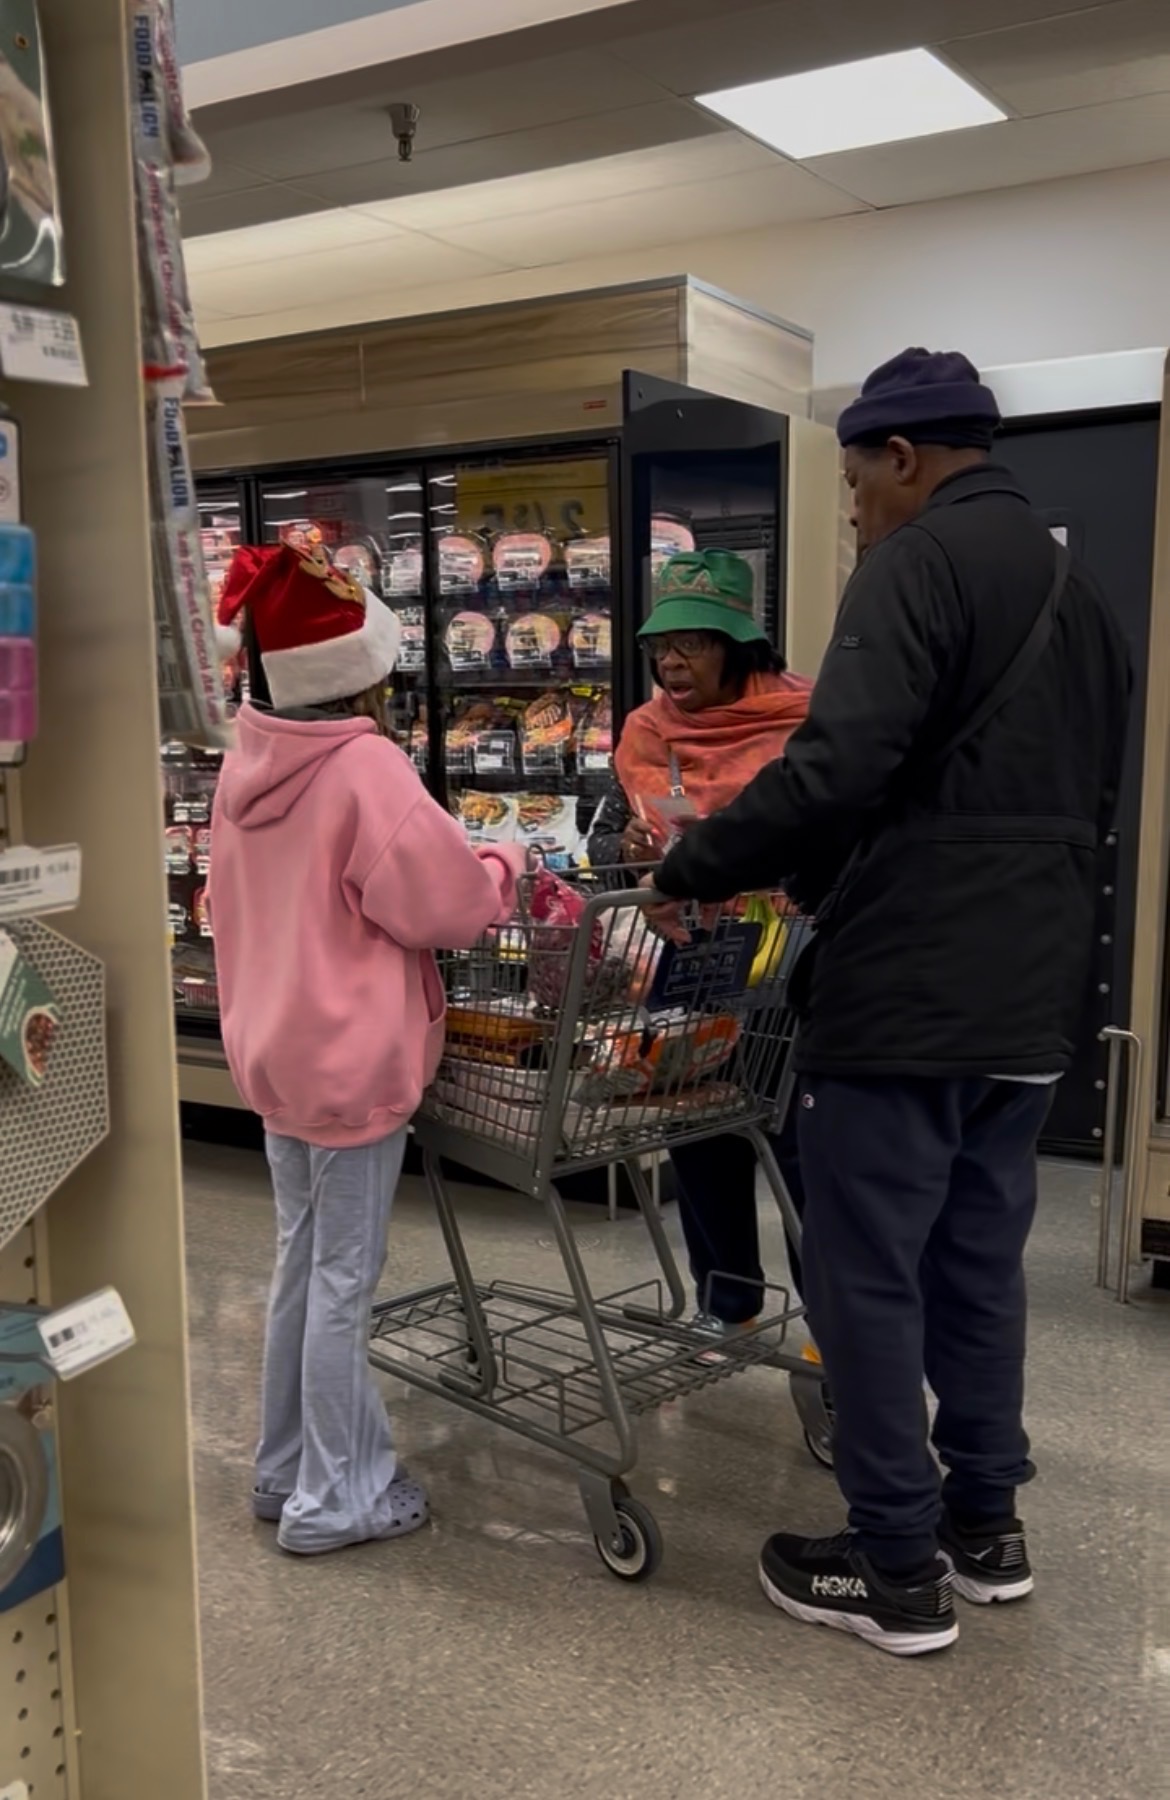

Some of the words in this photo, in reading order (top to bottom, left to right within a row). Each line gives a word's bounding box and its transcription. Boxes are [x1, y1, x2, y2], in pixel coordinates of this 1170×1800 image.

[134, 15, 151, 65] FOOD
[163, 396, 180, 443] FOOD
[169, 468, 189, 507] LION
[811, 1574, 869, 1599] HOKA
